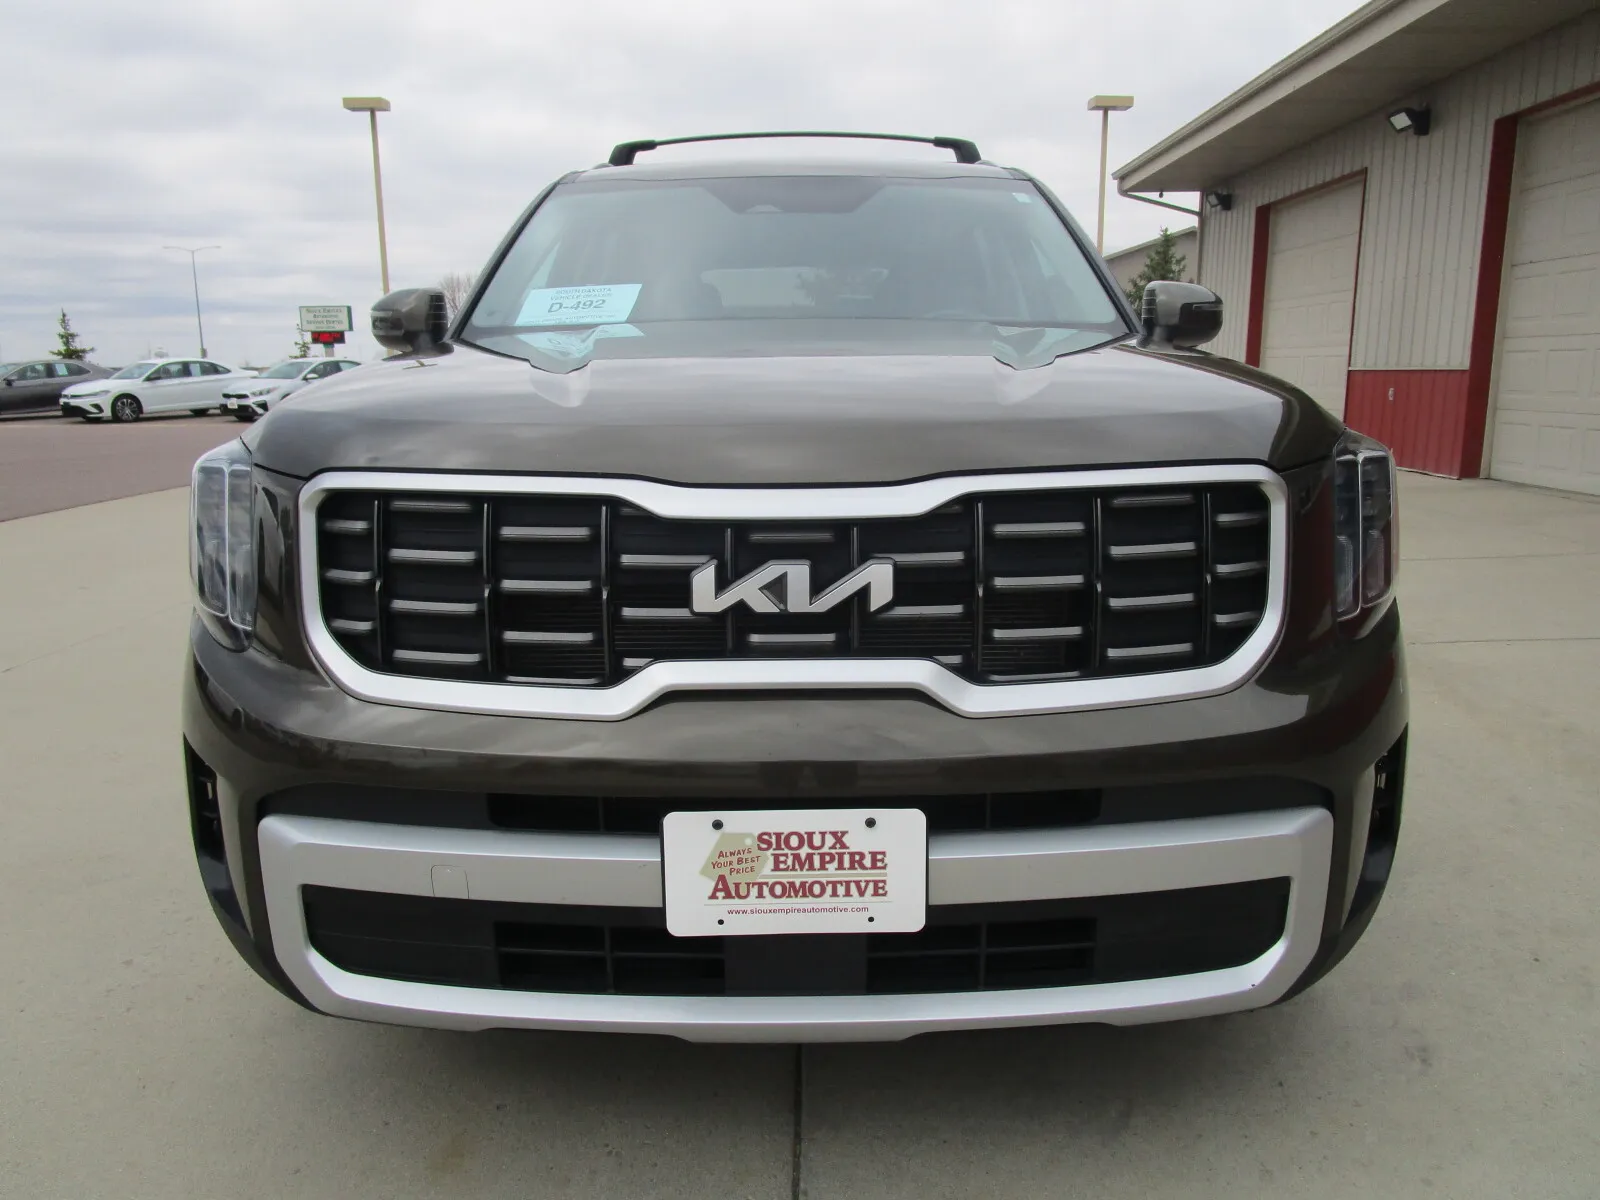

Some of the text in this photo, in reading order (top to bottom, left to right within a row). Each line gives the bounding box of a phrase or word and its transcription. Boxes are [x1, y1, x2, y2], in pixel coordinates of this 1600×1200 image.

[547, 298, 607, 314] D-492
[756, 830, 850, 851] SIOUX
[717, 847, 753, 860] ALWAYS
[711, 855, 762, 870] YOUR BEST
[770, 851, 888, 872] EMPIRE
[729, 866, 757, 877] PRICE
[707, 873, 888, 900] AUTOMOTIVE
[726, 905, 870, 916] www.siouxempireautomotive.com
